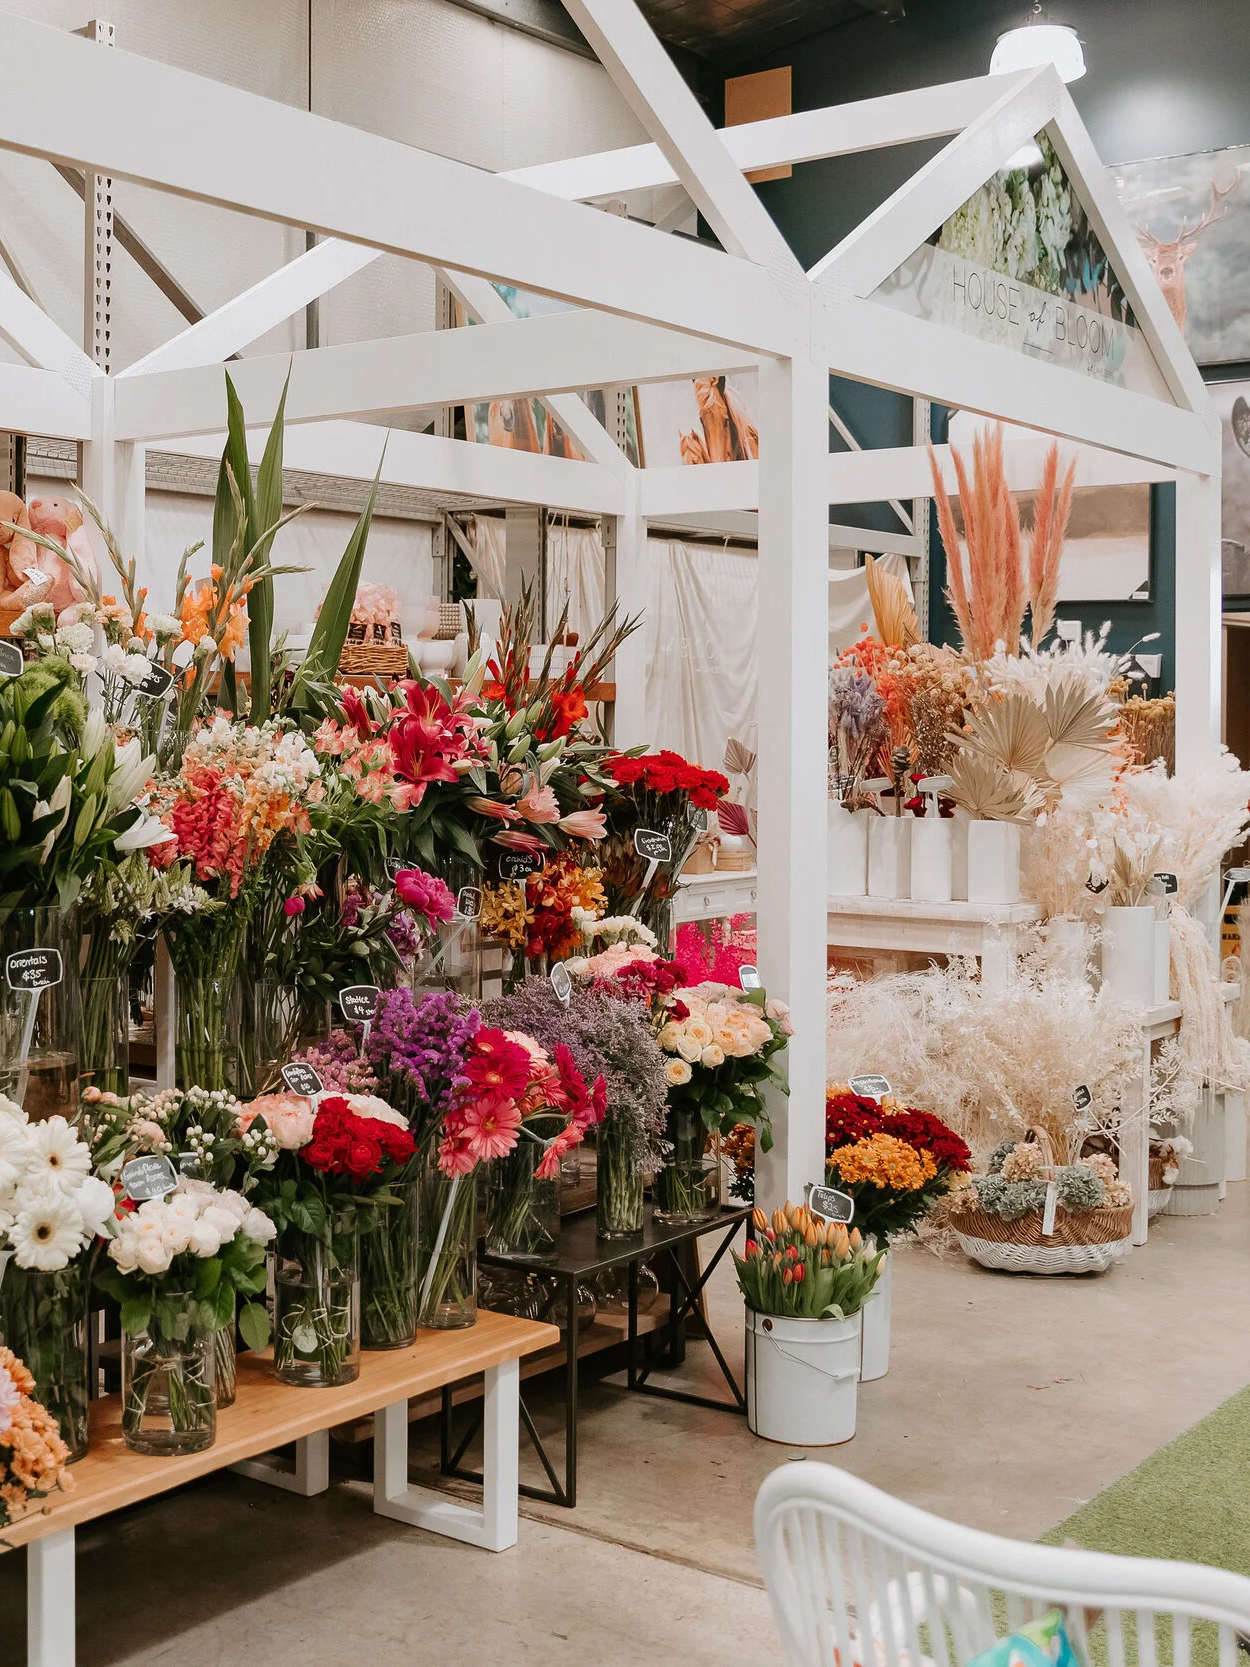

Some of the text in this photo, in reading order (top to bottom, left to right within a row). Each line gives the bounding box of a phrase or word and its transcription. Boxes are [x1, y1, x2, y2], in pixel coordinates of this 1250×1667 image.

[952, 264, 1115, 361] HOUSE of BLOOM
